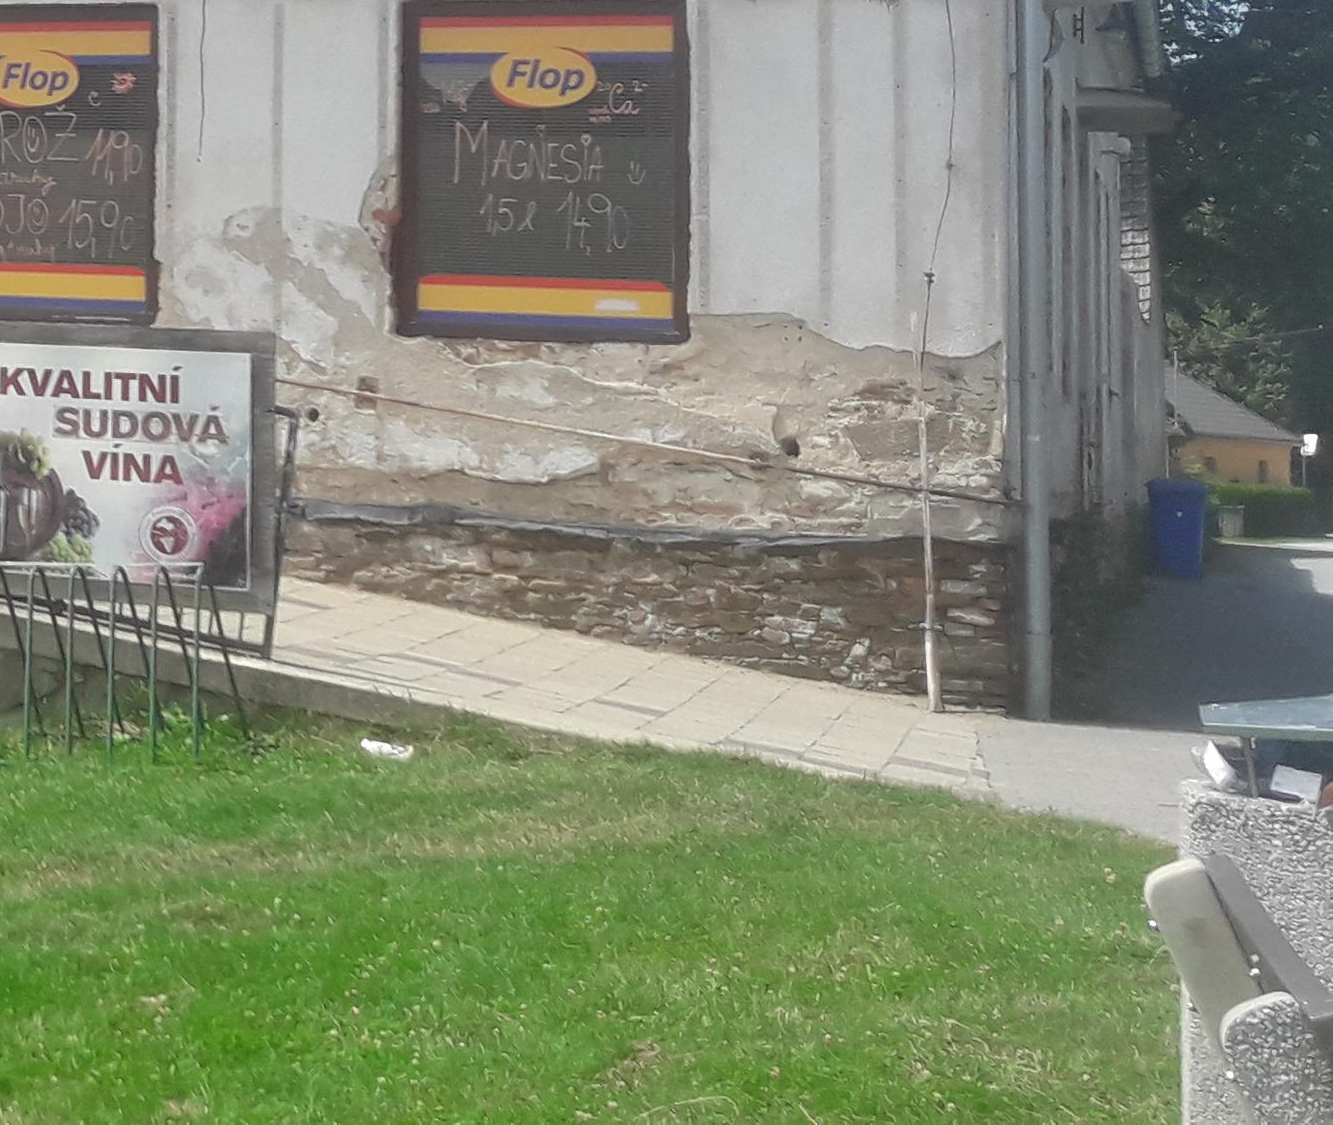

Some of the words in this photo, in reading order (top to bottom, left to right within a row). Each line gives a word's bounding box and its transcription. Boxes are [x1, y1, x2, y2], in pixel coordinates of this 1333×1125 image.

[2, 62, 70, 96] Flop
[506, 58, 585, 97] Flop
[452, 120, 605, 185] MAGNESIA
[54, 405, 230, 445] SUDOVÁ
[81, 443, 185, 486] VÍNA
